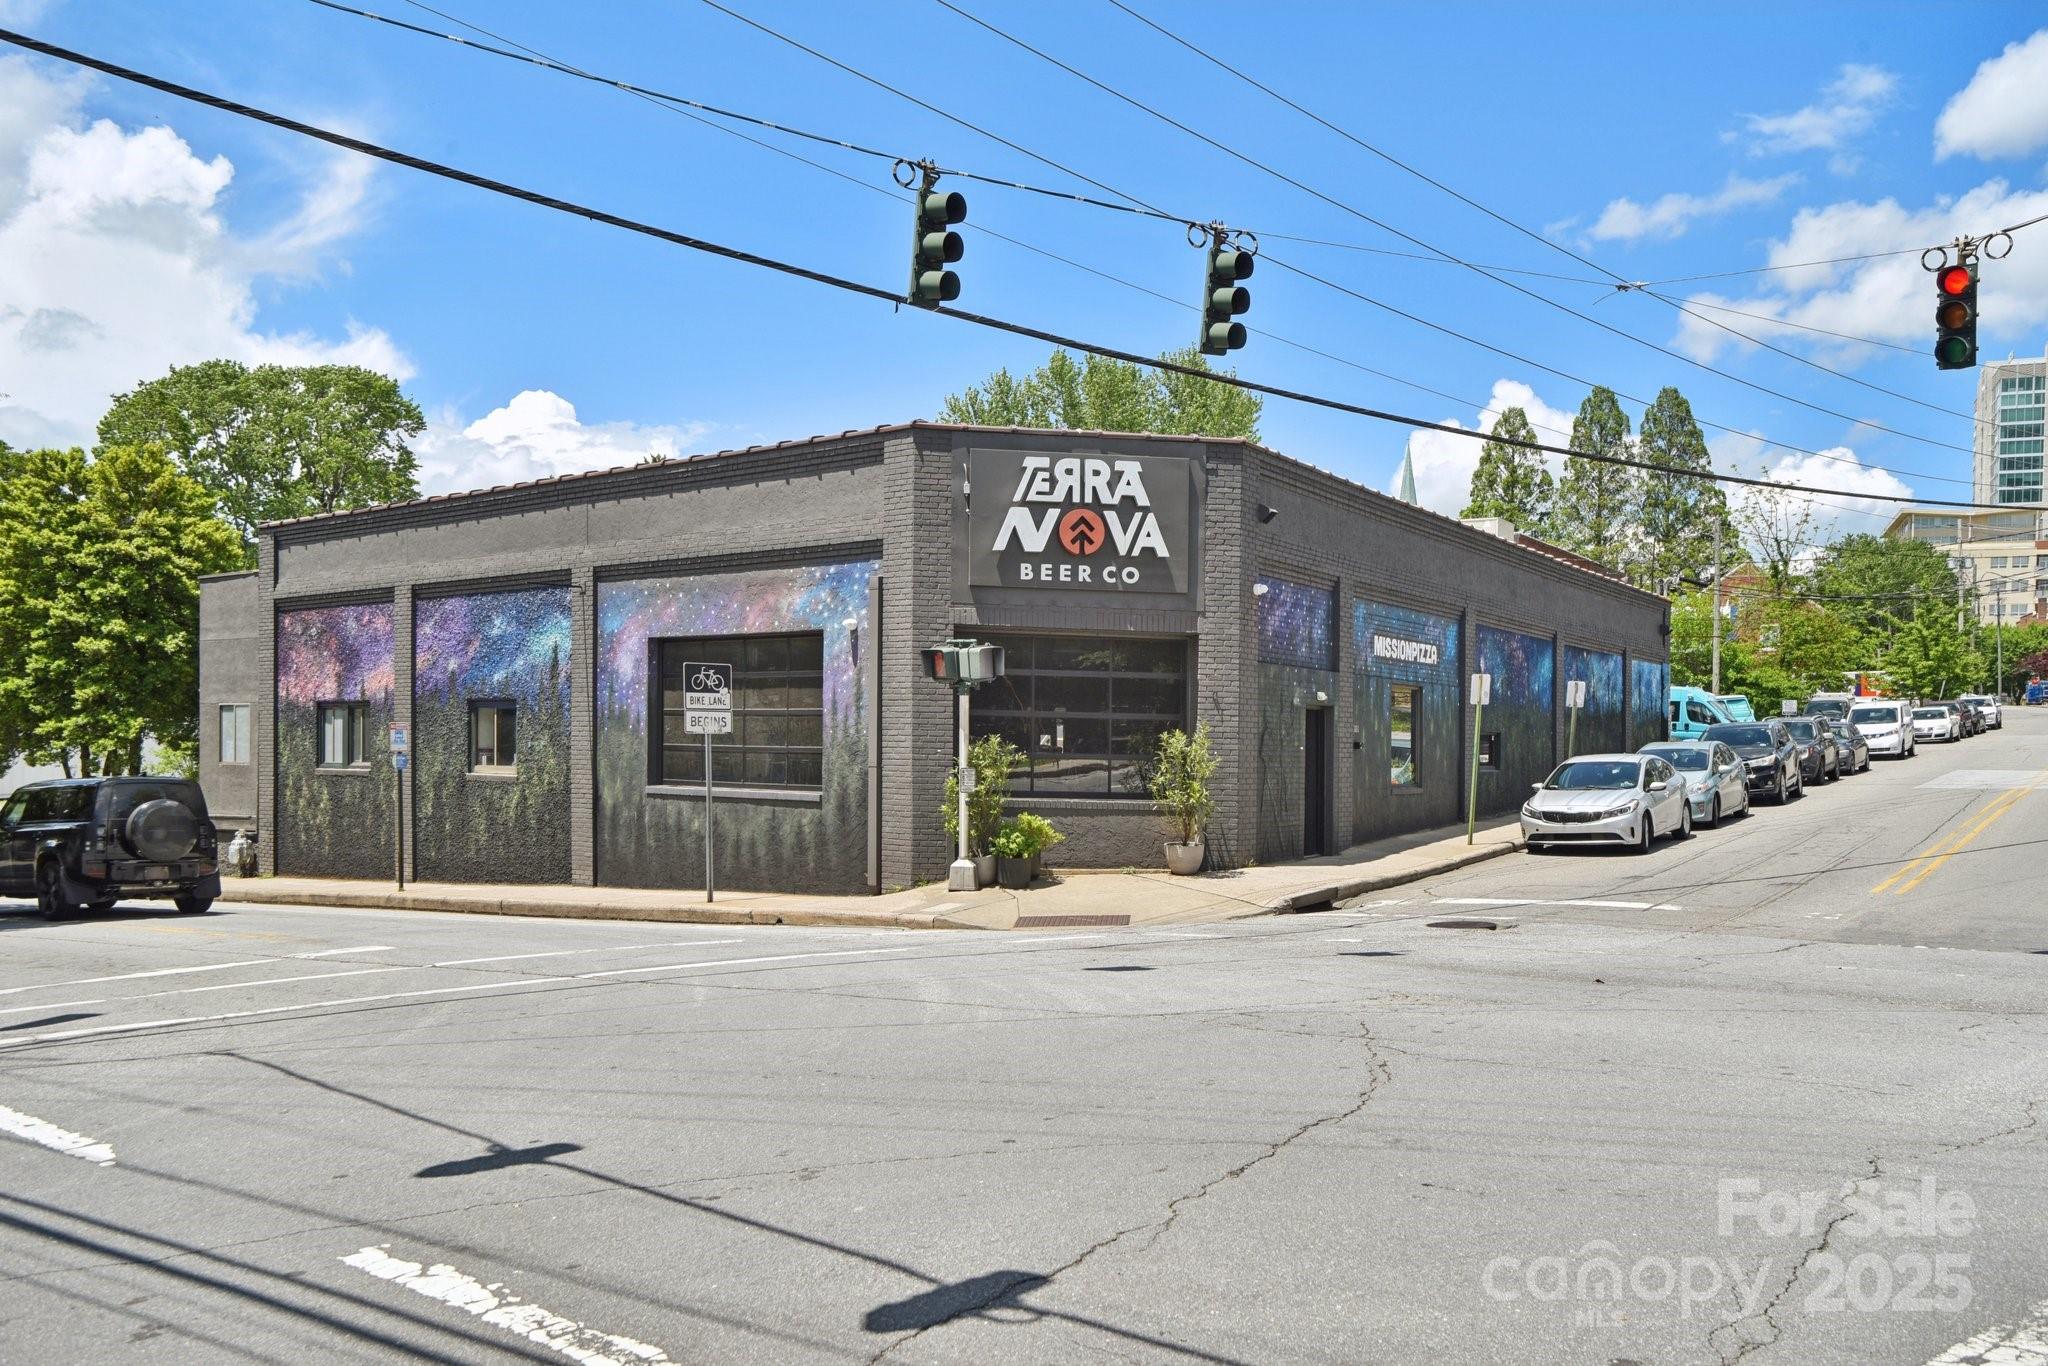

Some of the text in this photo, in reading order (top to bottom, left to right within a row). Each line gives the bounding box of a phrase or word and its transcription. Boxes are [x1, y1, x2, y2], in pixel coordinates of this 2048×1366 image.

[1012, 456, 1150, 507] TERRA
[992, 506, 1170, 558] NOVA
[1020, 563, 1140, 584] BEER CO
[1374, 635, 1437, 664] MISSIONPIZZA
[689, 696, 705, 705] BIKE
[690, 716, 727, 728] BEGINS
